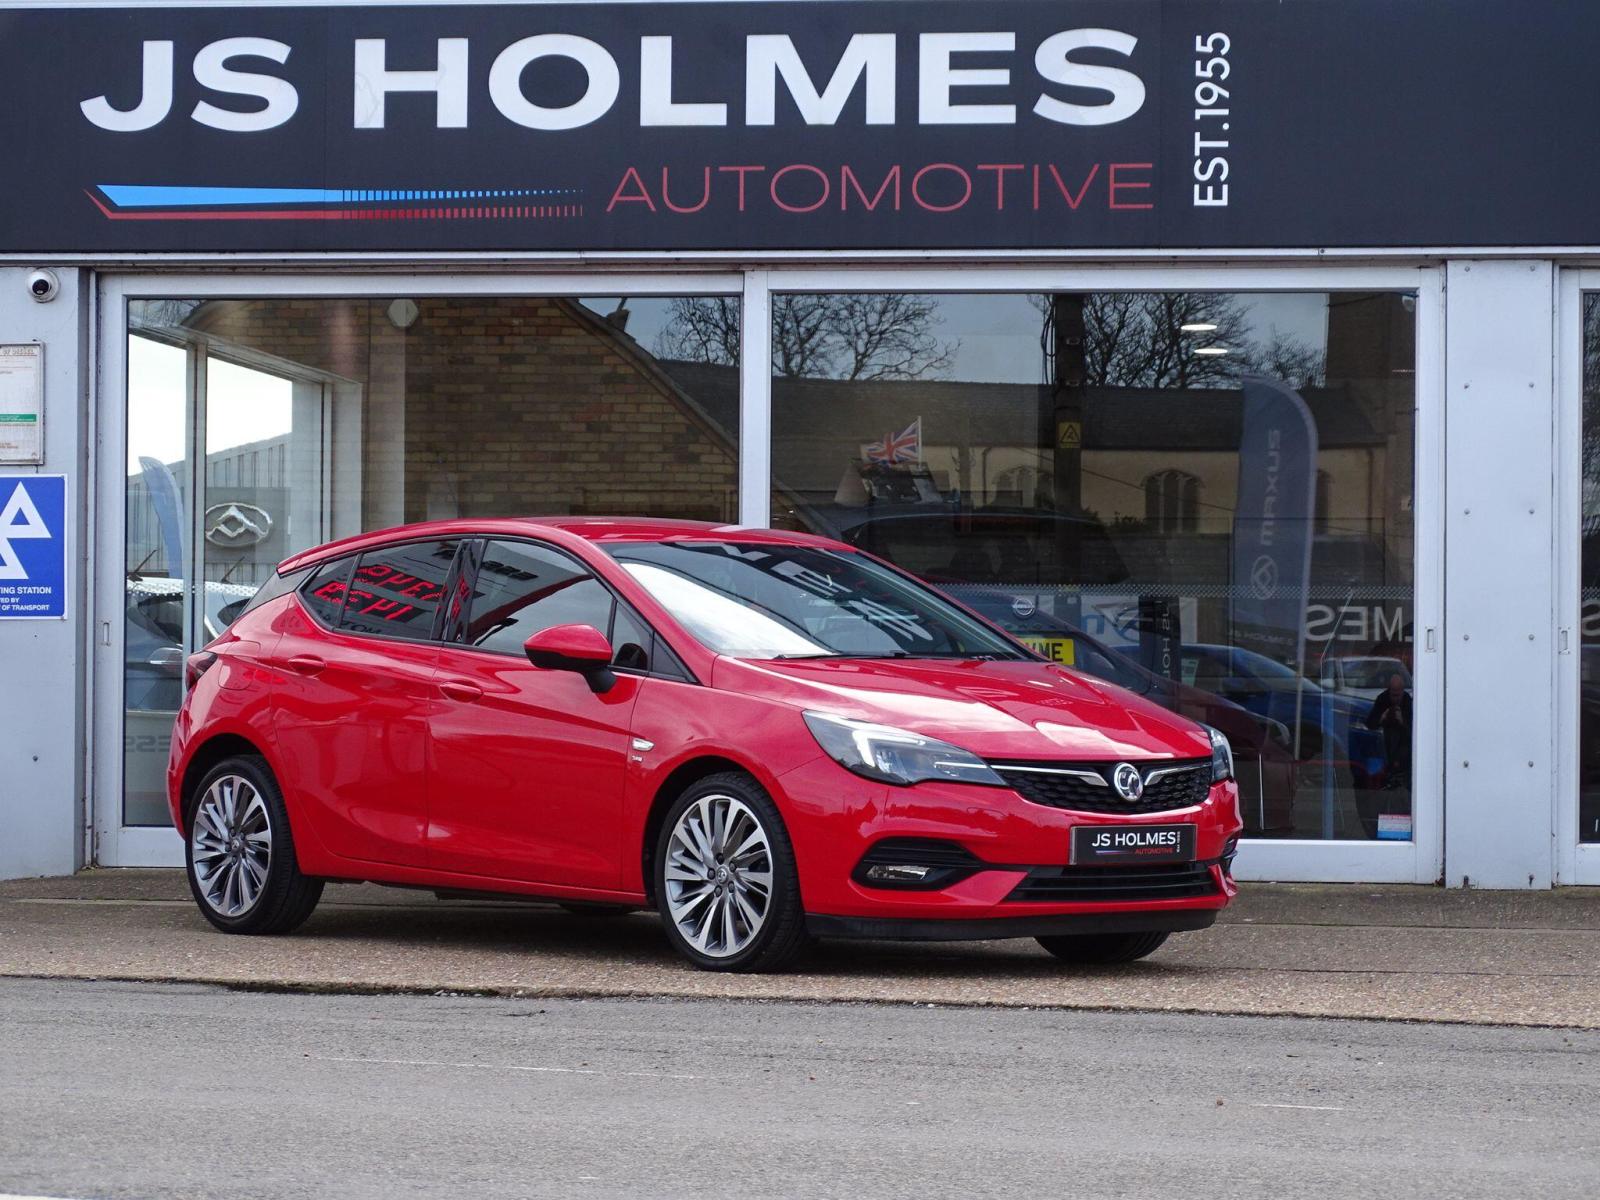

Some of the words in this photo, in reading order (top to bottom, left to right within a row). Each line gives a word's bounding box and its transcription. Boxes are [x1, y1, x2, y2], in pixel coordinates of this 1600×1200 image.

[80, 37, 299, 132] JS
[354, 27, 1146, 130] HOLMES
[1194, 31, 1231, 207] EST.1955
[606, 162, 1154, 214] AUTOMOTIVE
[17, 586, 52, 594] STATION
[1092, 833, 1110, 847] JS
[1115, 832, 1176, 846] HOLMES
